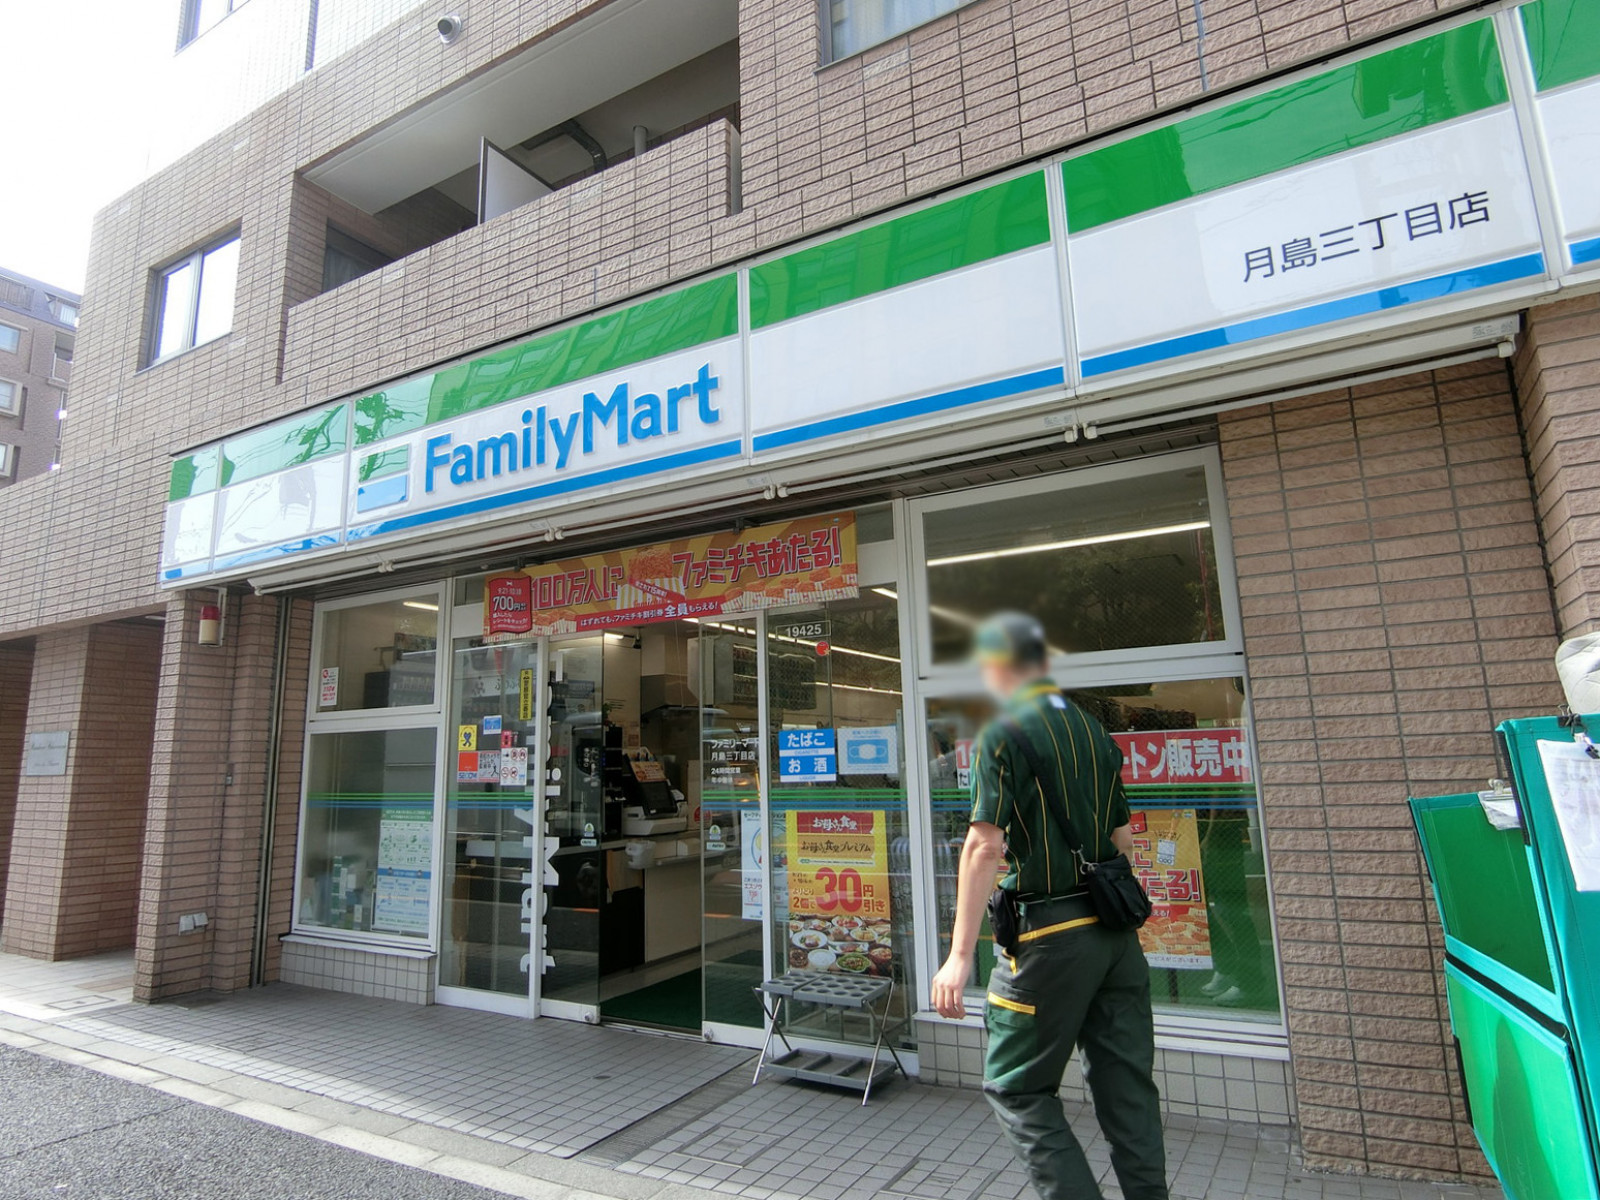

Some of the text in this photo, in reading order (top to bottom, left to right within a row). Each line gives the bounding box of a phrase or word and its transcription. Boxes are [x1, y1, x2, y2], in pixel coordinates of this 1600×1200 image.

[1244, 191, 1490, 283] 月島三丁目店
[424, 361, 720, 494] FamilyMart
[532, 566, 623, 611] 100万人に
[785, 623, 822, 638] 19425
[711, 737, 760, 750] ファミリーマート
[787, 732, 826, 748] たばこ
[711, 751, 756, 762] 月島三丁目店
[812, 815, 858, 832] お母さん食堂
[801, 839, 871, 854] お母さん食堂プレミアム
[814, 866, 863, 913] 30
